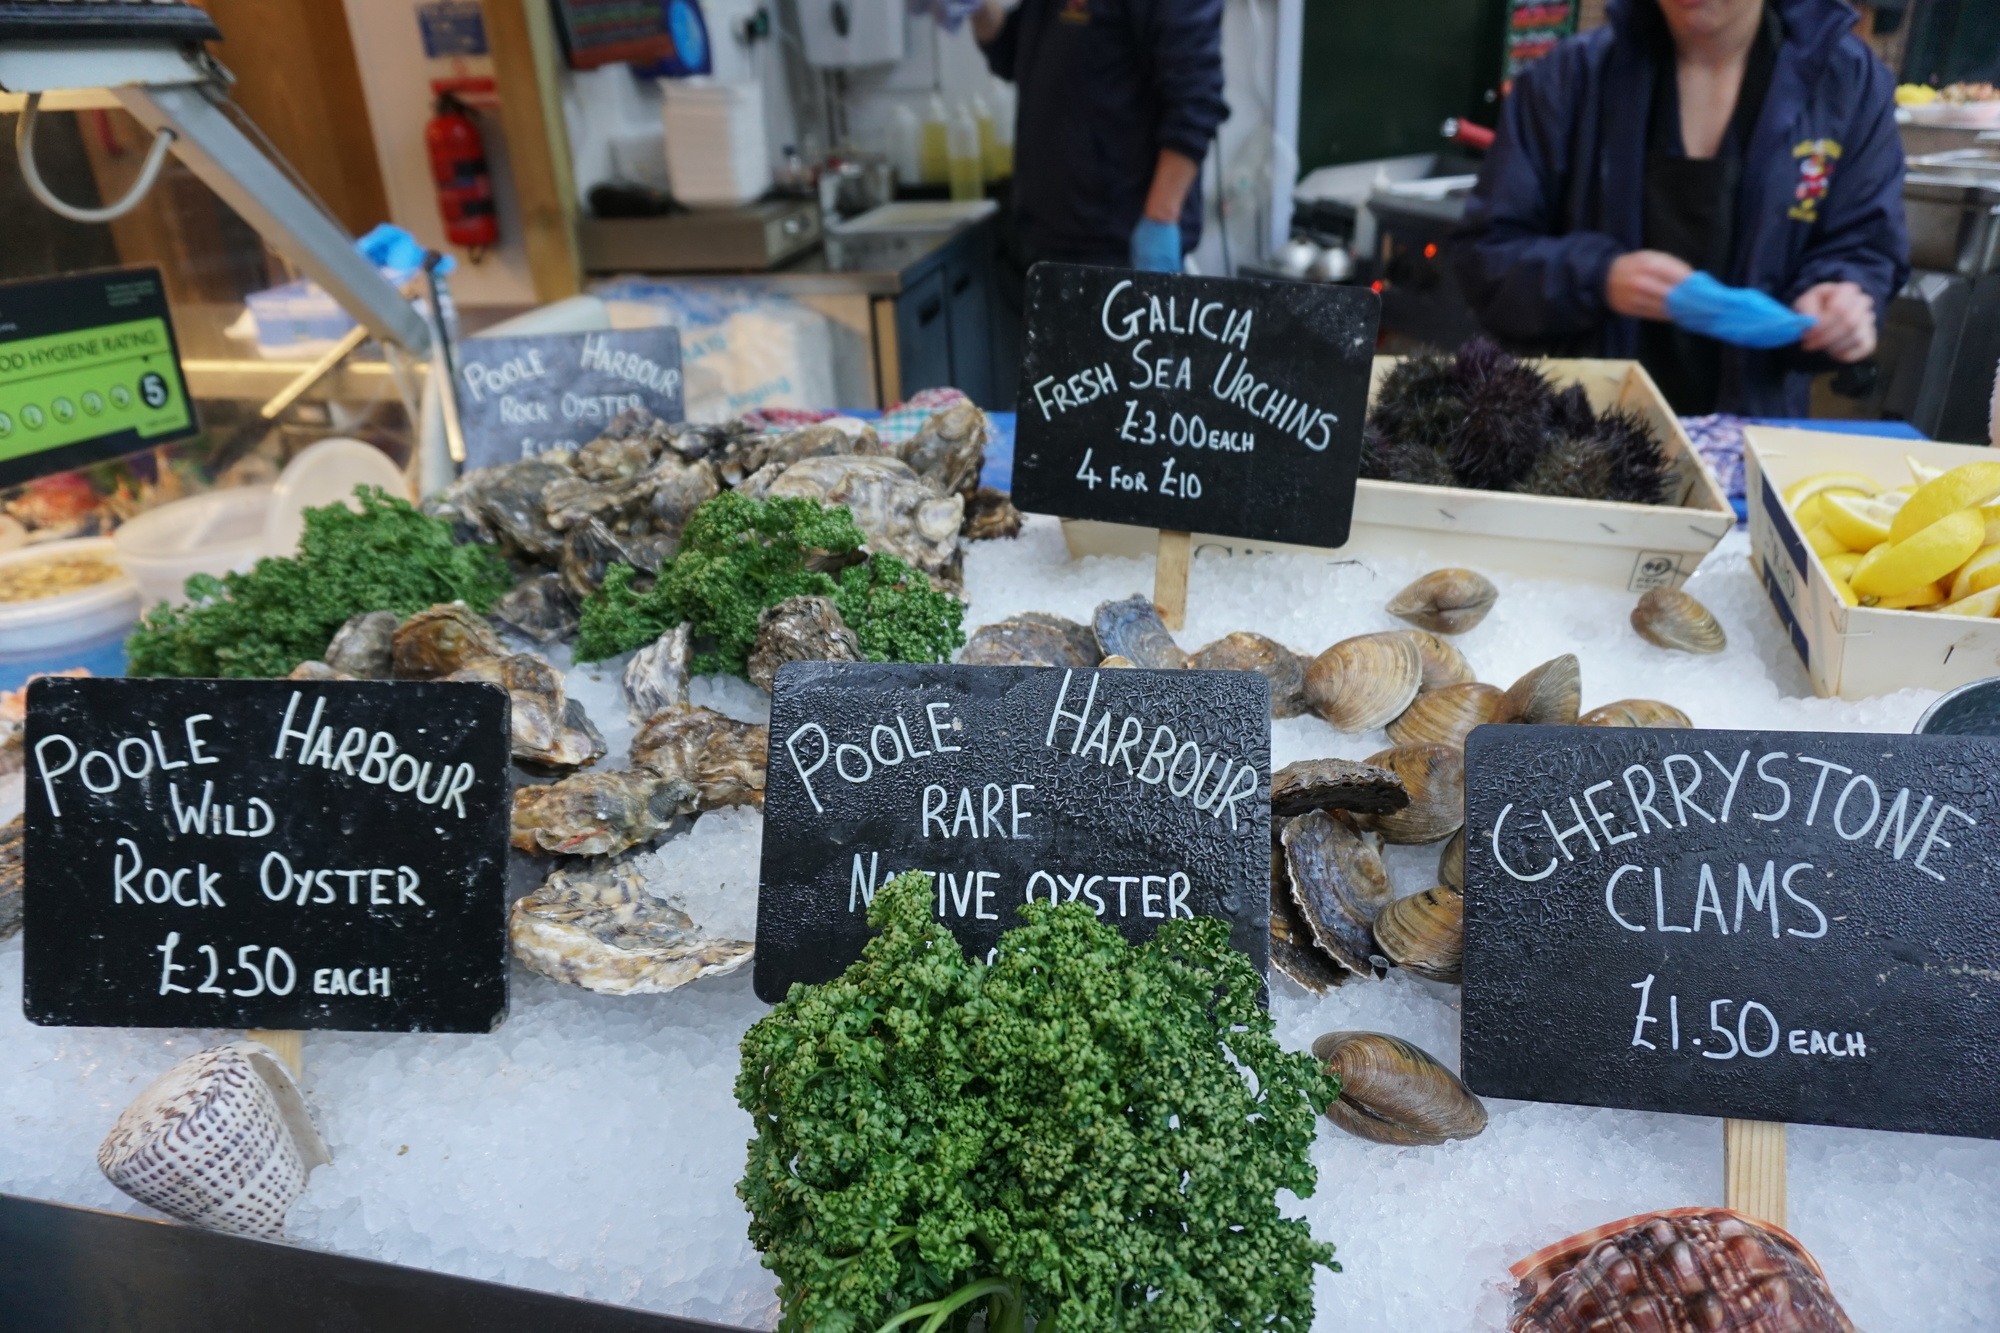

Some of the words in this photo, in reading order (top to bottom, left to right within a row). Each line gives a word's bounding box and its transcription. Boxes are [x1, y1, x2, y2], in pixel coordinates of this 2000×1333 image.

[28, 339, 98, 367] HYGIENE
[102, 329, 157, 351] RATING
[1102, 280, 1253, 350] GALICIA
[143, 374, 166, 408] 5
[463, 348, 546, 402] POOLE
[580, 333, 679, 398] HARBOUR
[1033, 362, 1118, 422] FRESH
[1129, 339, 1191, 391] SEA
[1213, 352, 1338, 451] URCHINS
[500, 395, 549, 424] ROCK
[1120, 400, 1207, 449] £3.00
[1208, 430, 1254, 452] EACH
[1076, 447, 1102, 491] 4
[1110, 466, 1148, 492] FOR
[1159, 457, 1202, 499] £10
[34, 713, 219, 818] POOLE
[275, 690, 475, 819] HARBOUR
[786, 702, 961, 813] POOLE
[1046, 668, 1258, 830] HARBOUR
[170, 780, 275, 837] WILD
[922, 783, 1035, 840] RARE
[1492, 749, 1976, 883] CHERRYSTONE
[114, 838, 226, 908] ROCK
[260, 851, 425, 907] OYSTER
[849, 852, 1001, 920] NIVE
[1026, 870, 1194, 920] OYSTER
[1605, 860, 1828, 940] CLAMS
[156, 931, 297, 997] £2.50
[313, 967, 391, 997] EACH
[1631, 974, 1780, 1060] £1.50
[1788, 1030, 1867, 1058] EACH
